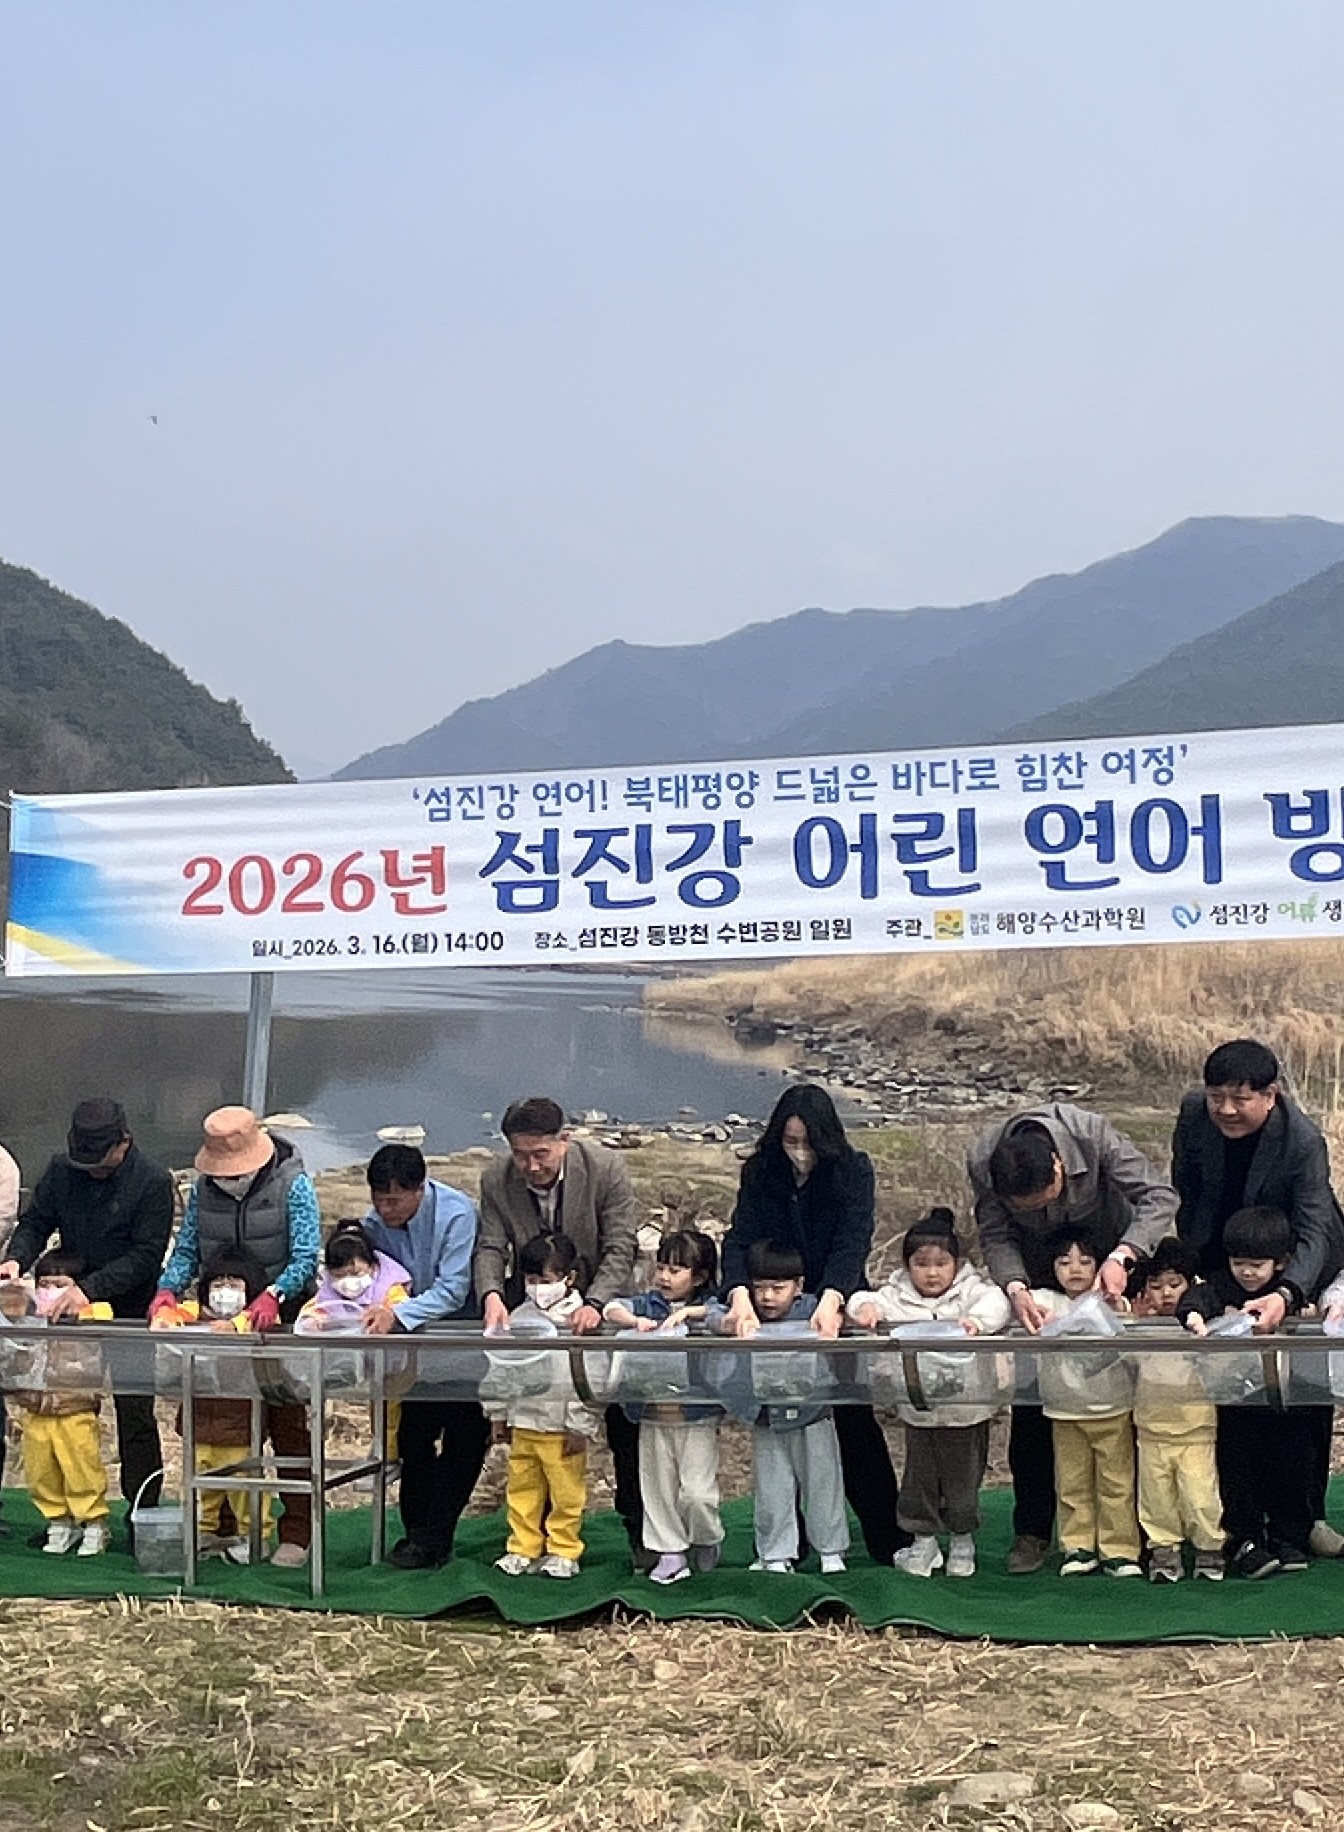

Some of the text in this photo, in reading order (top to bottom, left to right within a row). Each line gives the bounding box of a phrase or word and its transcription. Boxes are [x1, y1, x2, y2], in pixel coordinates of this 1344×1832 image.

[412, 743, 1188, 823] ‘섬진강 연어! 북태평양 드넓은 바다로 힘찬 여정’
[181, 845, 449, 917] 2026년
[479, 819, 753, 914] 섬진강
[793, 806, 982, 900] 어린
[1024, 793, 1225, 892] 연어
[996, 907, 1146, 935] 해양수산과학원
[1209, 902, 1270, 925] 섬진강
[347, 935, 367, 955] 3.
[373, 932, 438, 956] 16.(월)
[445, 931, 504, 952] 14:00
[647, 923, 708, 946] 동방천
[716, 919, 802, 944] 수변공원
[810, 917, 853, 941] 일원
